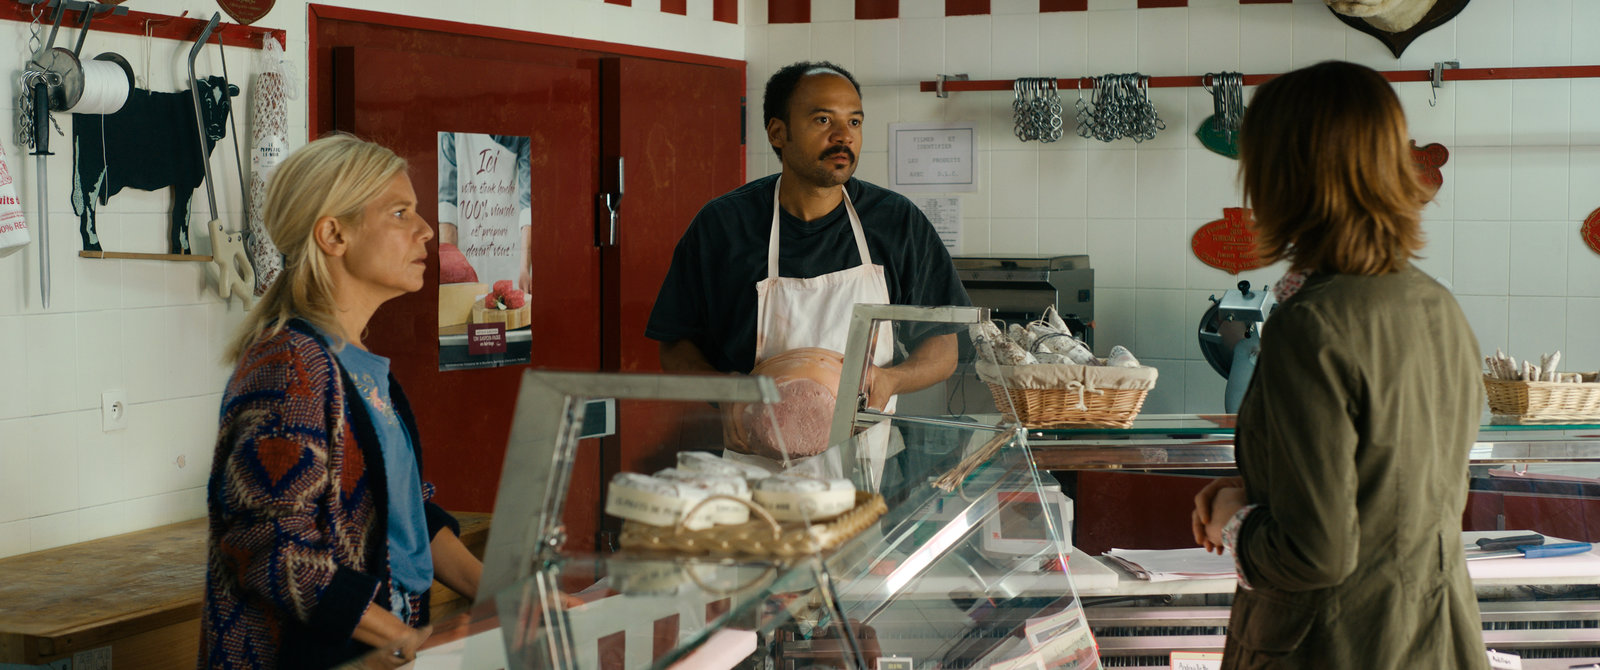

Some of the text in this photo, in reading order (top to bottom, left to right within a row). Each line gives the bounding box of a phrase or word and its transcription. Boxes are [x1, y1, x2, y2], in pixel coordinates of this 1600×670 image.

[476, 148, 500, 175] Ici
[461, 181, 478, 194] votre
[479, 182, 497, 194] steak
[459, 200, 516, 220] 100% viande
[471, 223, 482, 237] est
[466, 241, 494, 258] devant
